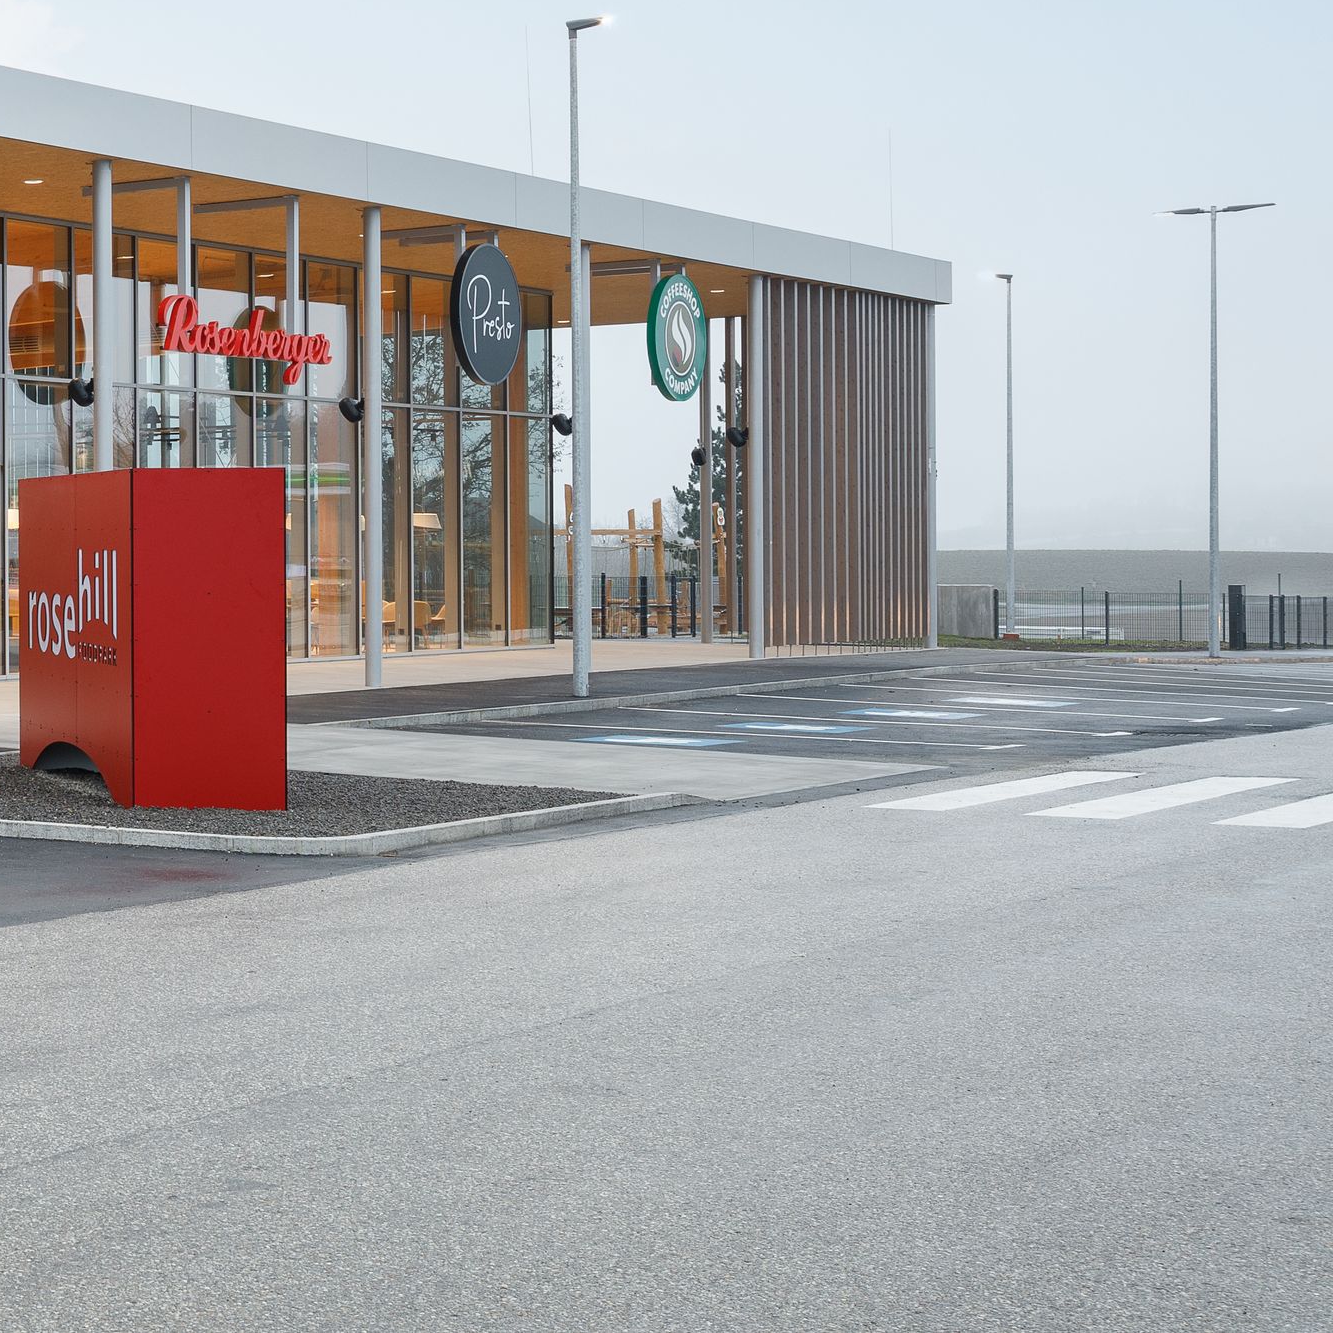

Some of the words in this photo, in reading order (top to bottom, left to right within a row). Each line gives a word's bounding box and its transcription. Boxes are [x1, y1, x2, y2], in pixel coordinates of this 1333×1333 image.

[466, 274, 515, 354] Presto
[660, 282, 701, 319] COFFEESHOP
[158, 294, 333, 385] Rosenberger
[664, 367, 699, 395] COMPANY
[78, 641, 117, 666] FOODPARK
